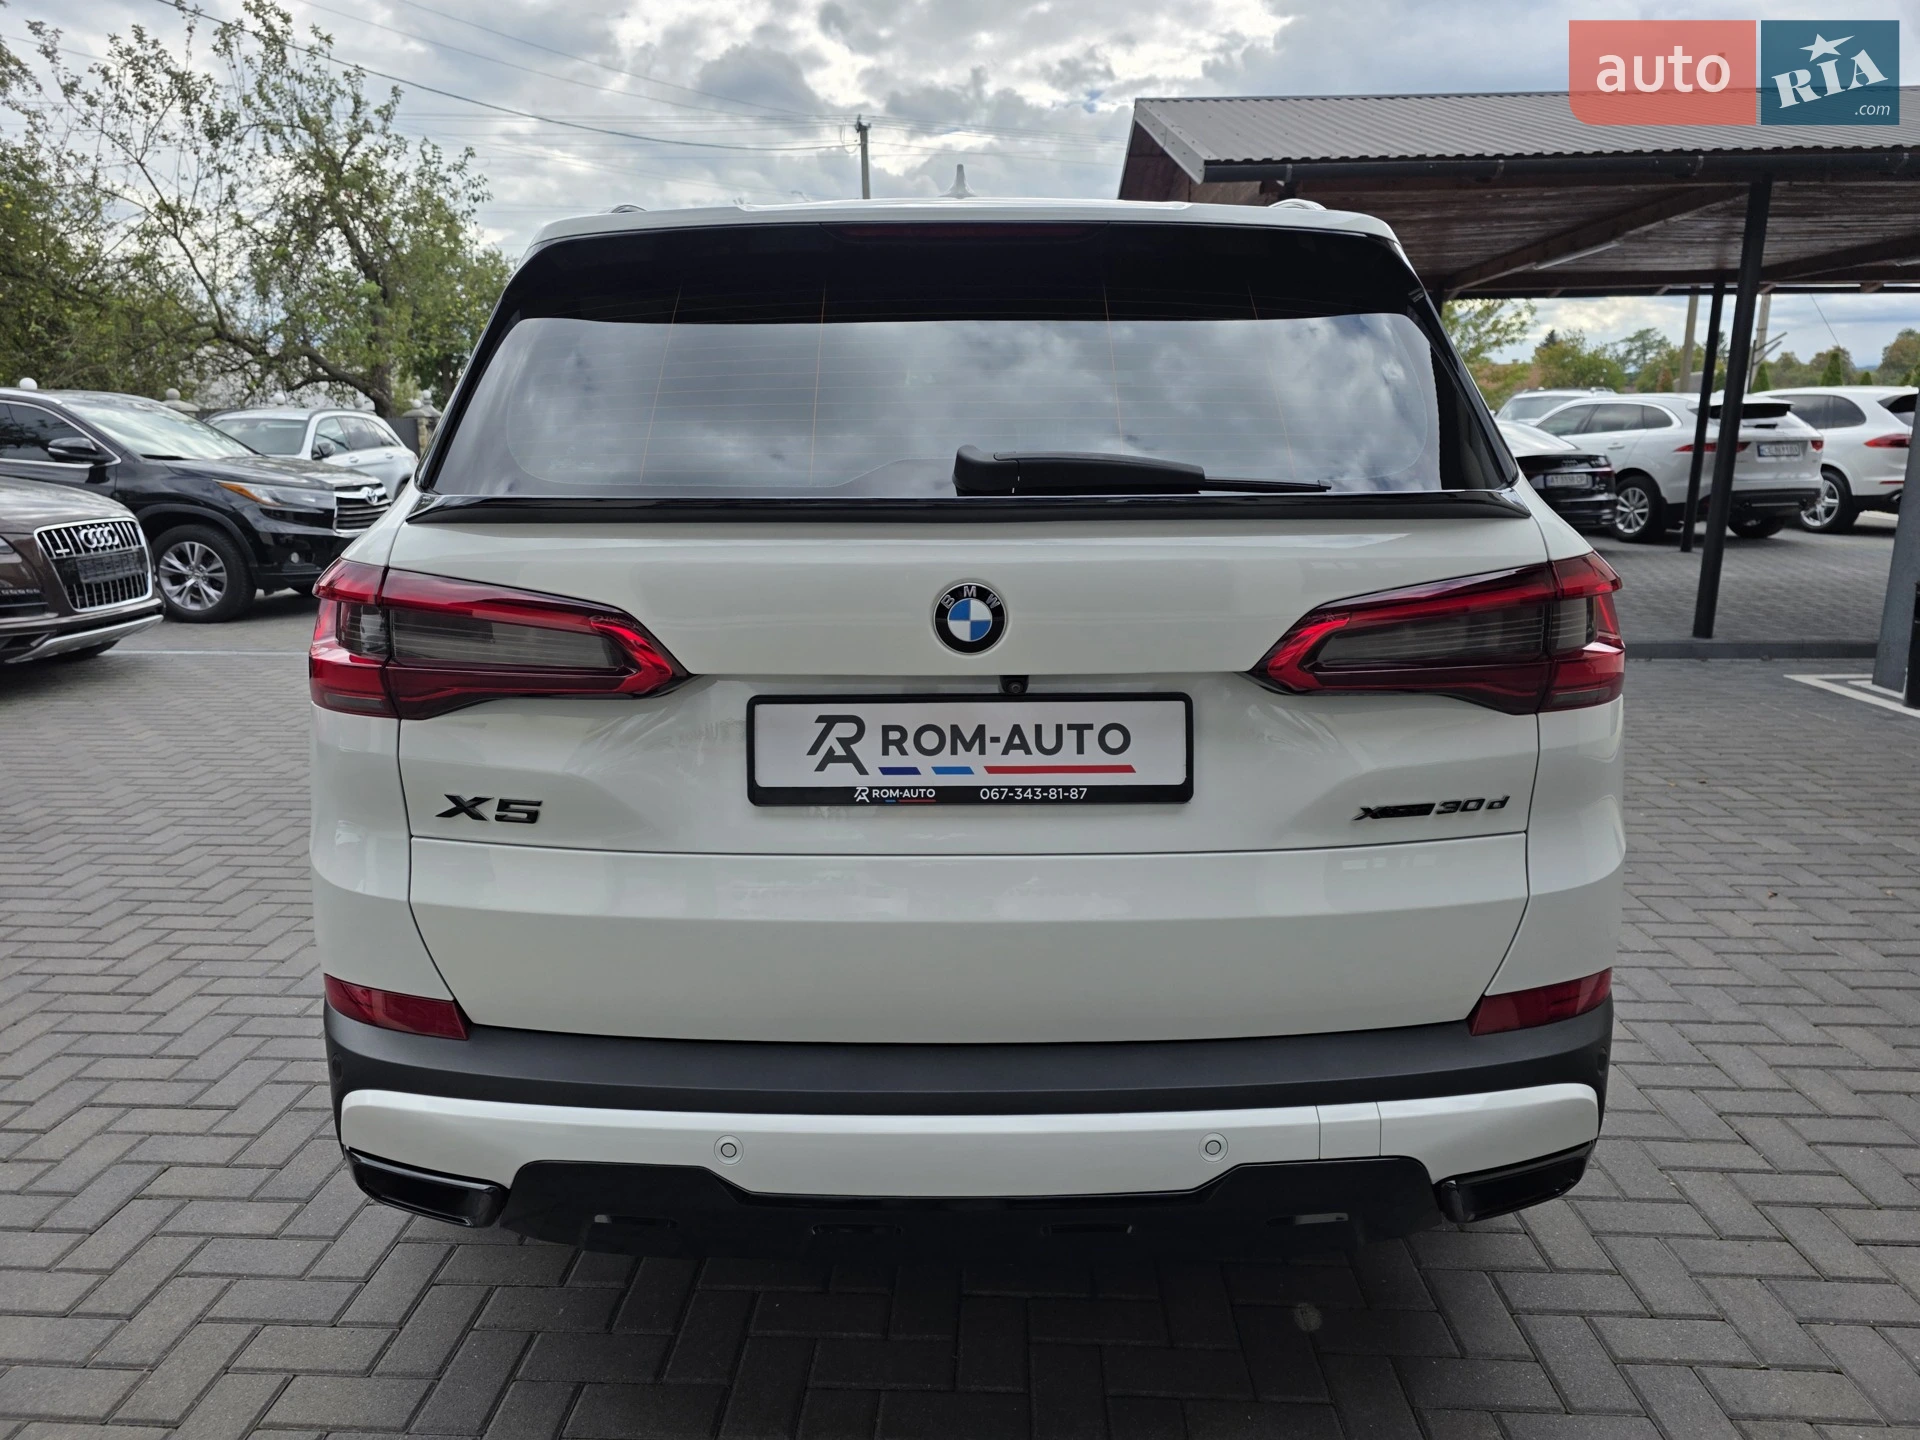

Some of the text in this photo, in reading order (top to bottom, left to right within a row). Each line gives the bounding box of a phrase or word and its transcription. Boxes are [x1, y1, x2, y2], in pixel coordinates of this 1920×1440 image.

[940, 585, 1001, 609] BMW
[881, 723, 1132, 757] ROM-AUTO
[872, 788, 936, 799] ROM-AUTO
[979, 787, 1088, 800] 067-343-81-87
[435, 793, 544, 824] X5
